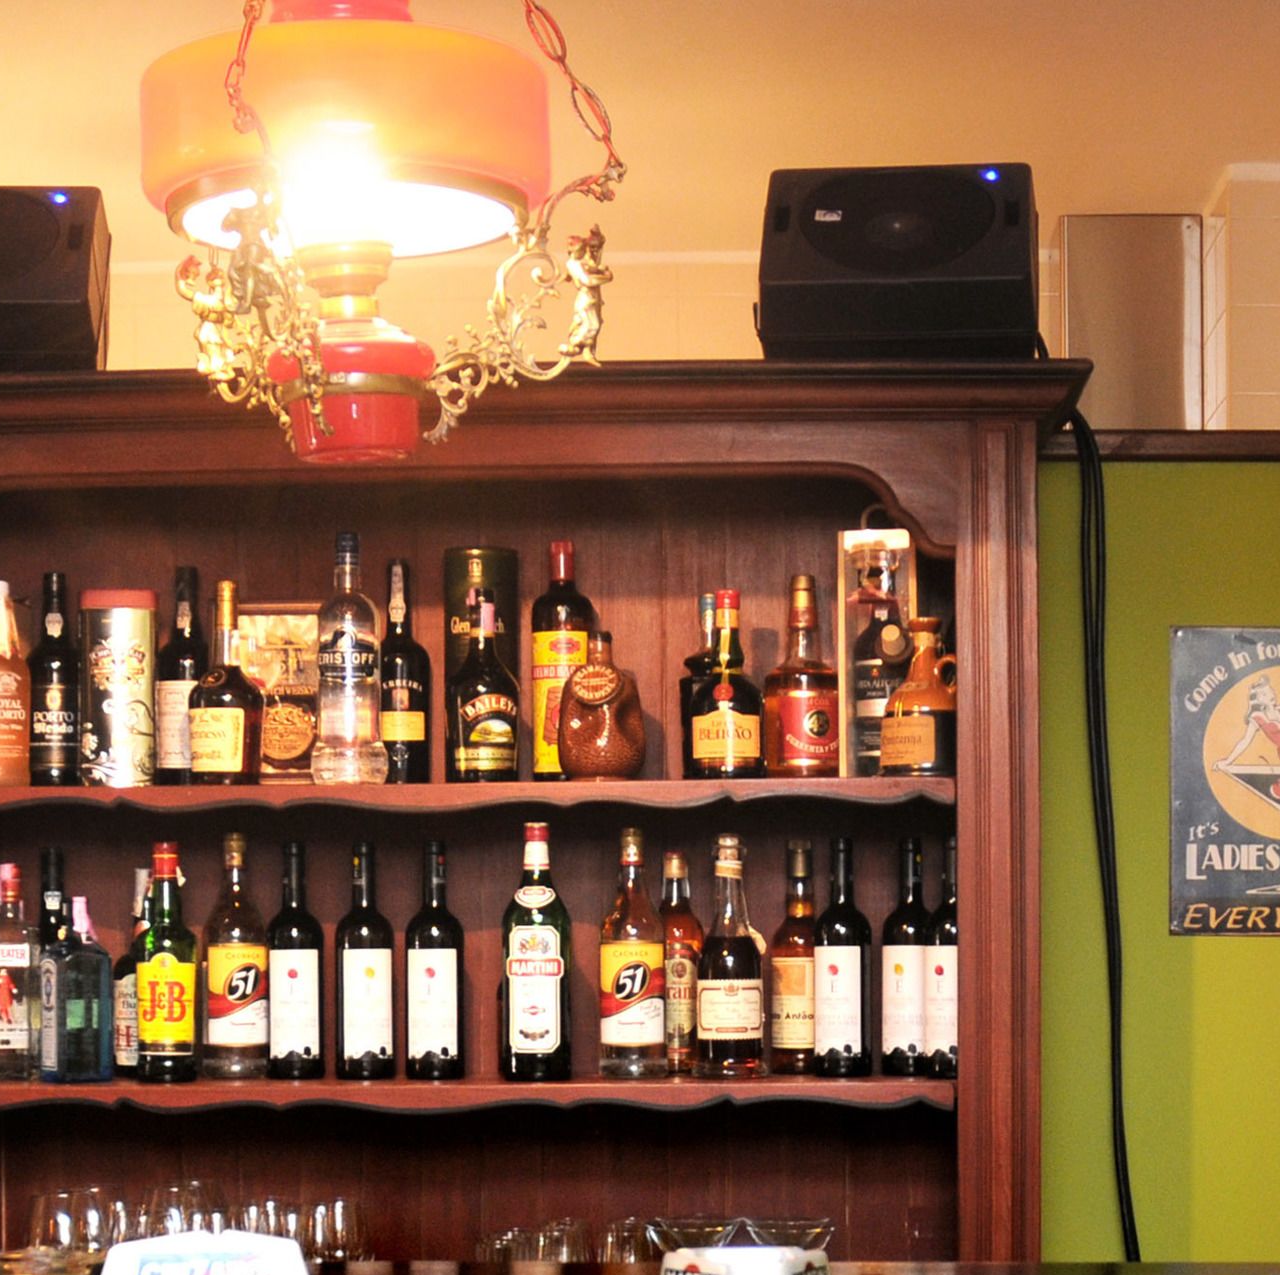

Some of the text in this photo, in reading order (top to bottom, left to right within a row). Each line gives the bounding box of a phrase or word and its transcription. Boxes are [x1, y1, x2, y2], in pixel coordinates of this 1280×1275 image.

[319, 653, 375, 664] ERISOFF
[382, 679, 423, 692] ERREIRA
[1184, 664, 1228, 713] Come
[1229, 650, 1252, 670] In
[33, 711, 74, 722] PORTO
[1188, 820, 1220, 841] It's
[1185, 843, 1280, 881] LADIES
[511, 960, 559, 975] MARTINI
[228, 968, 256, 1000] 51
[615, 966, 644, 999] 51
[142, 980, 187, 1022] J&B
